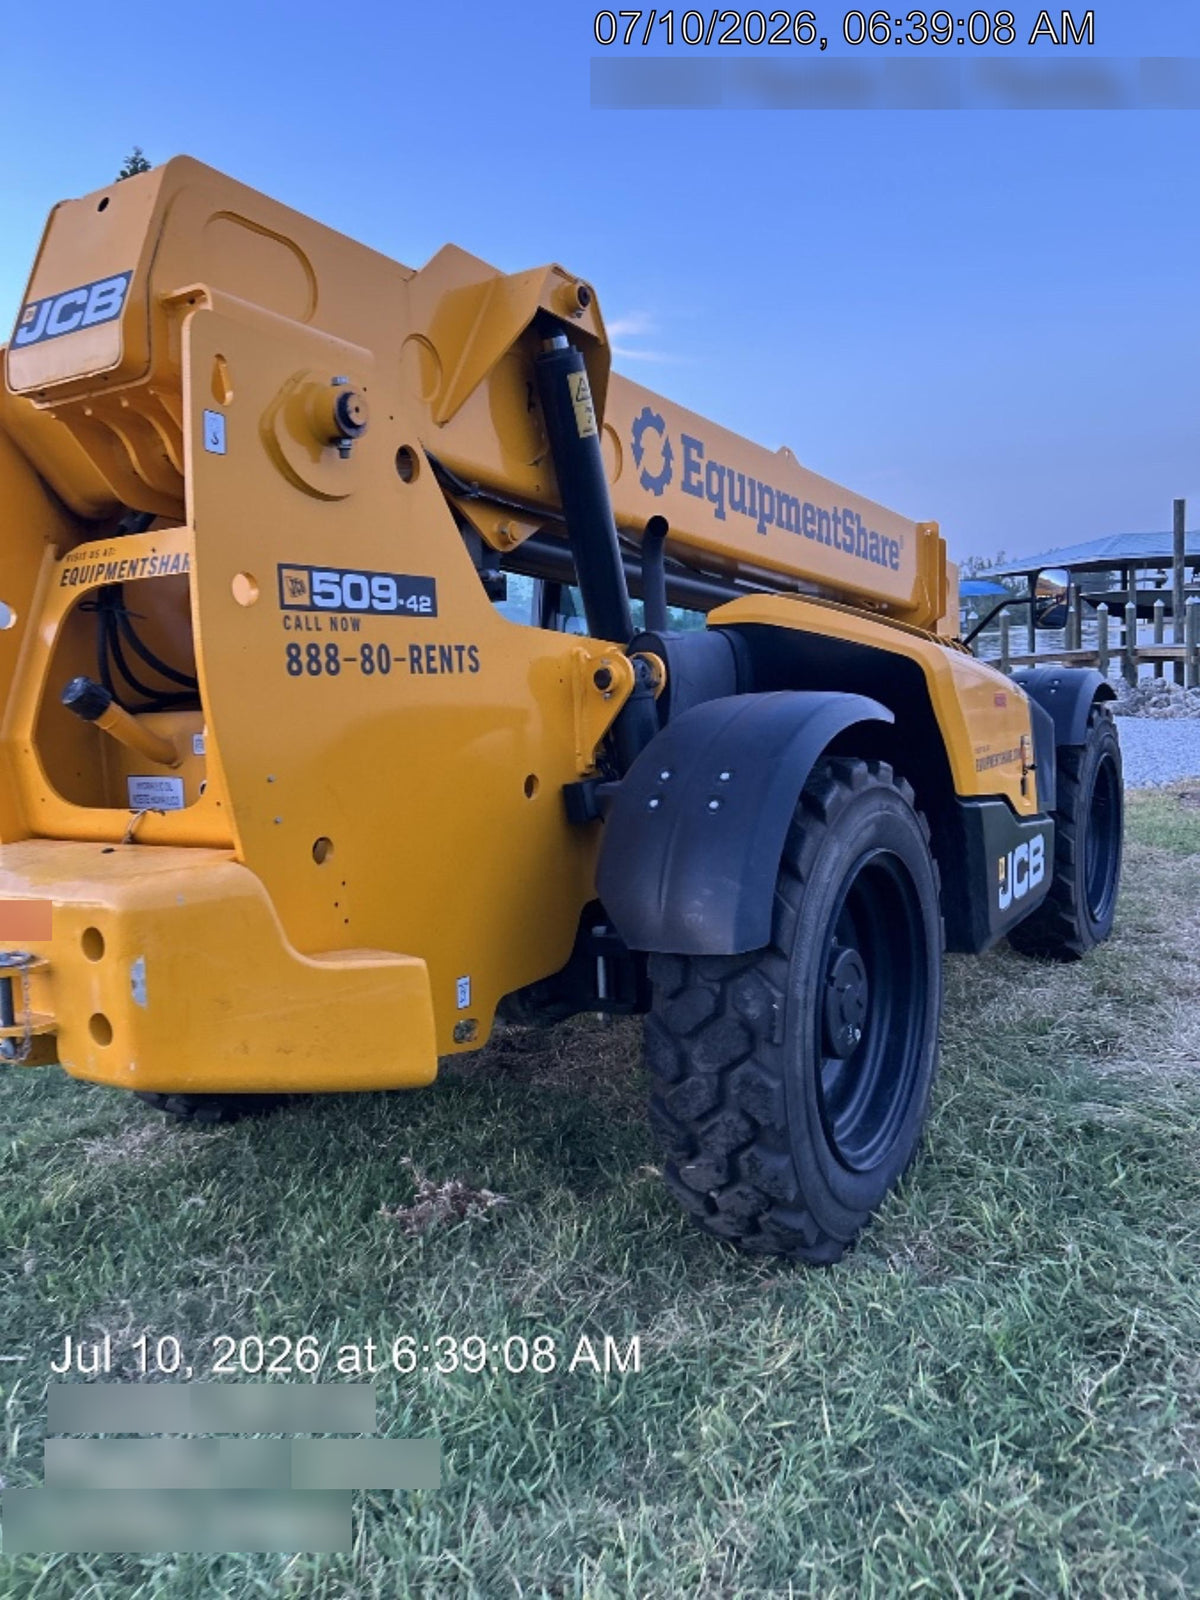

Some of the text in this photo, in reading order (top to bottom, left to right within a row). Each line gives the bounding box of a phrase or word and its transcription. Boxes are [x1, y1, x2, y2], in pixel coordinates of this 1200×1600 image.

[15, 276, 127, 344] JCB
[680, 433, 900, 571] EquipmentShare
[283, 615, 361, 632] CALL NOW
[285, 642, 480, 677] 888-80-RENTS
[998, 833, 1045, 910] JCB
